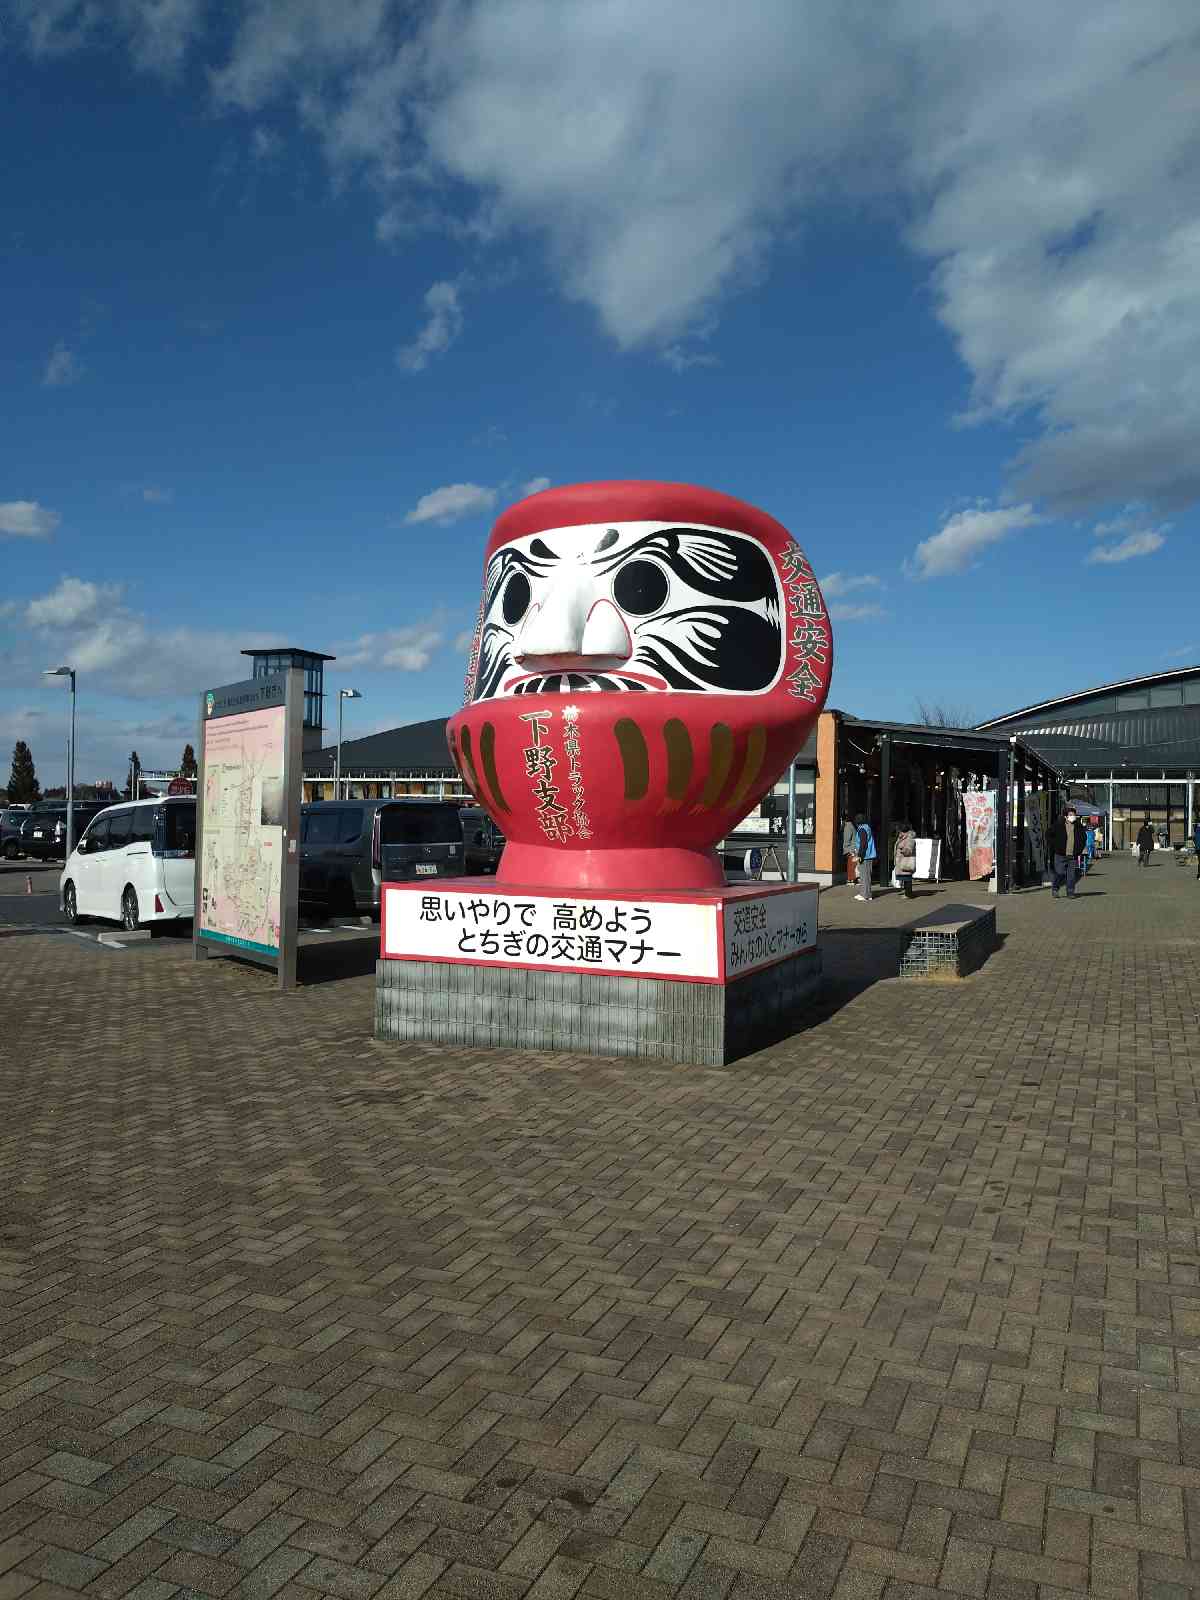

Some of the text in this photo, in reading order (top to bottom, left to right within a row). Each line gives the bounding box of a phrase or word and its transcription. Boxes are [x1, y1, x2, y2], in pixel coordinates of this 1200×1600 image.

[778, 540, 829, 703] 交通安全
[518, 709, 574, 844] 下野支部
[420, 896, 652, 934] 思いやりで 高めよう
[733, 903, 767, 936] 交通安全
[457, 927, 682, 965] とちぎの交通マナー
